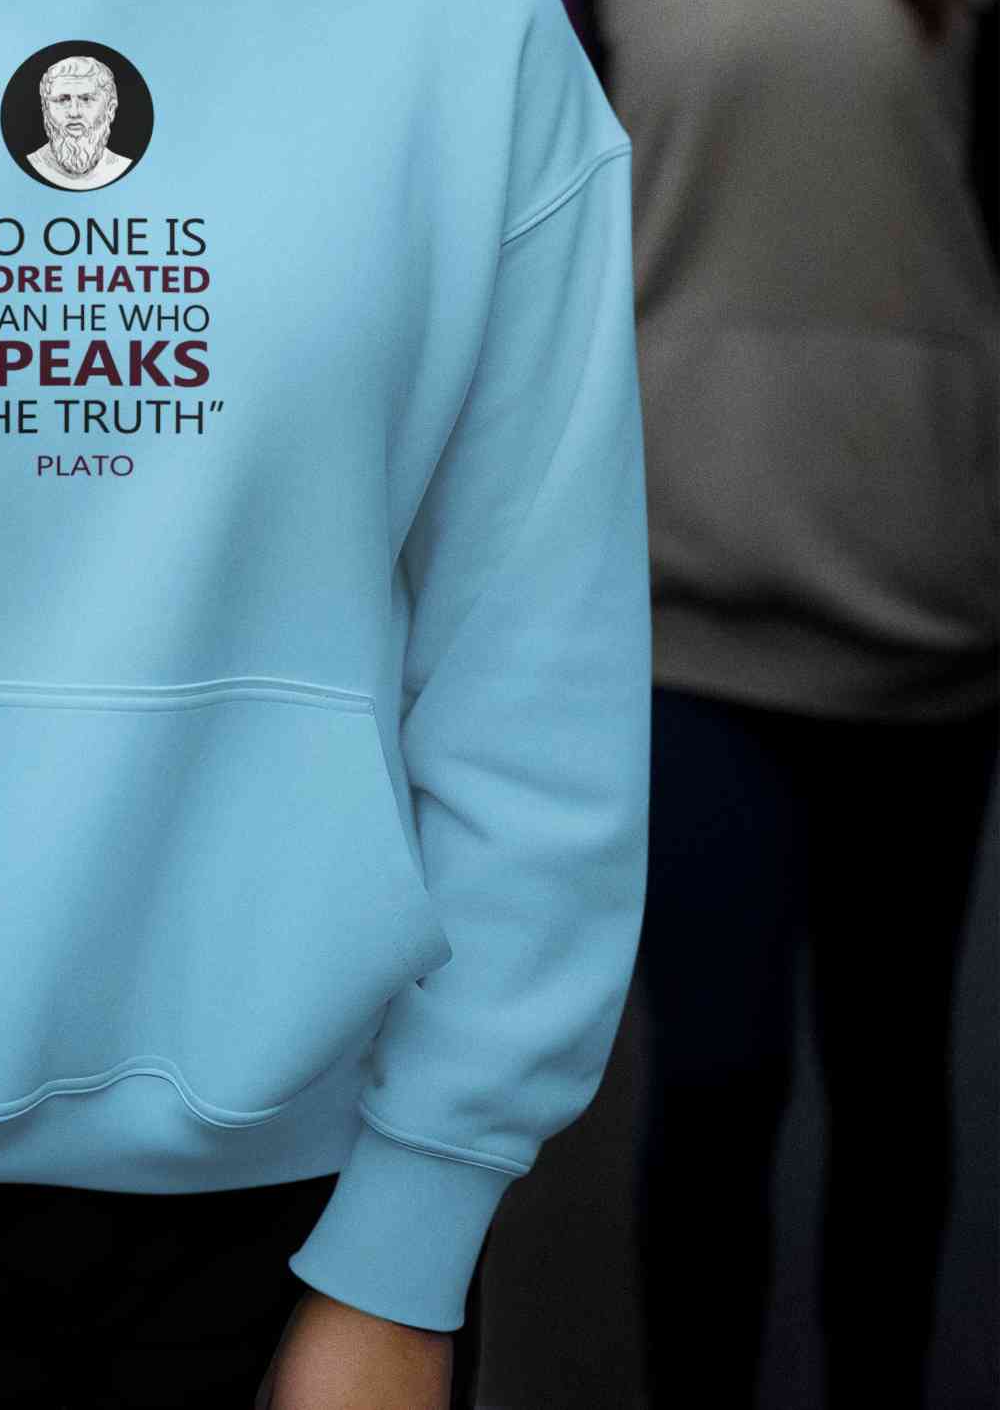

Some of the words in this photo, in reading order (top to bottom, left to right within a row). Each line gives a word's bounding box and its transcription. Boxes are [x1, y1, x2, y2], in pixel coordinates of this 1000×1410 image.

[43, 217, 149, 256] ONE
[165, 218, 207, 257] IS
[77, 265, 210, 294] HATED
[63, 303, 107, 332] HE
[118, 304, 210, 333] WHO
[37, 454, 134, 477] PLATO
